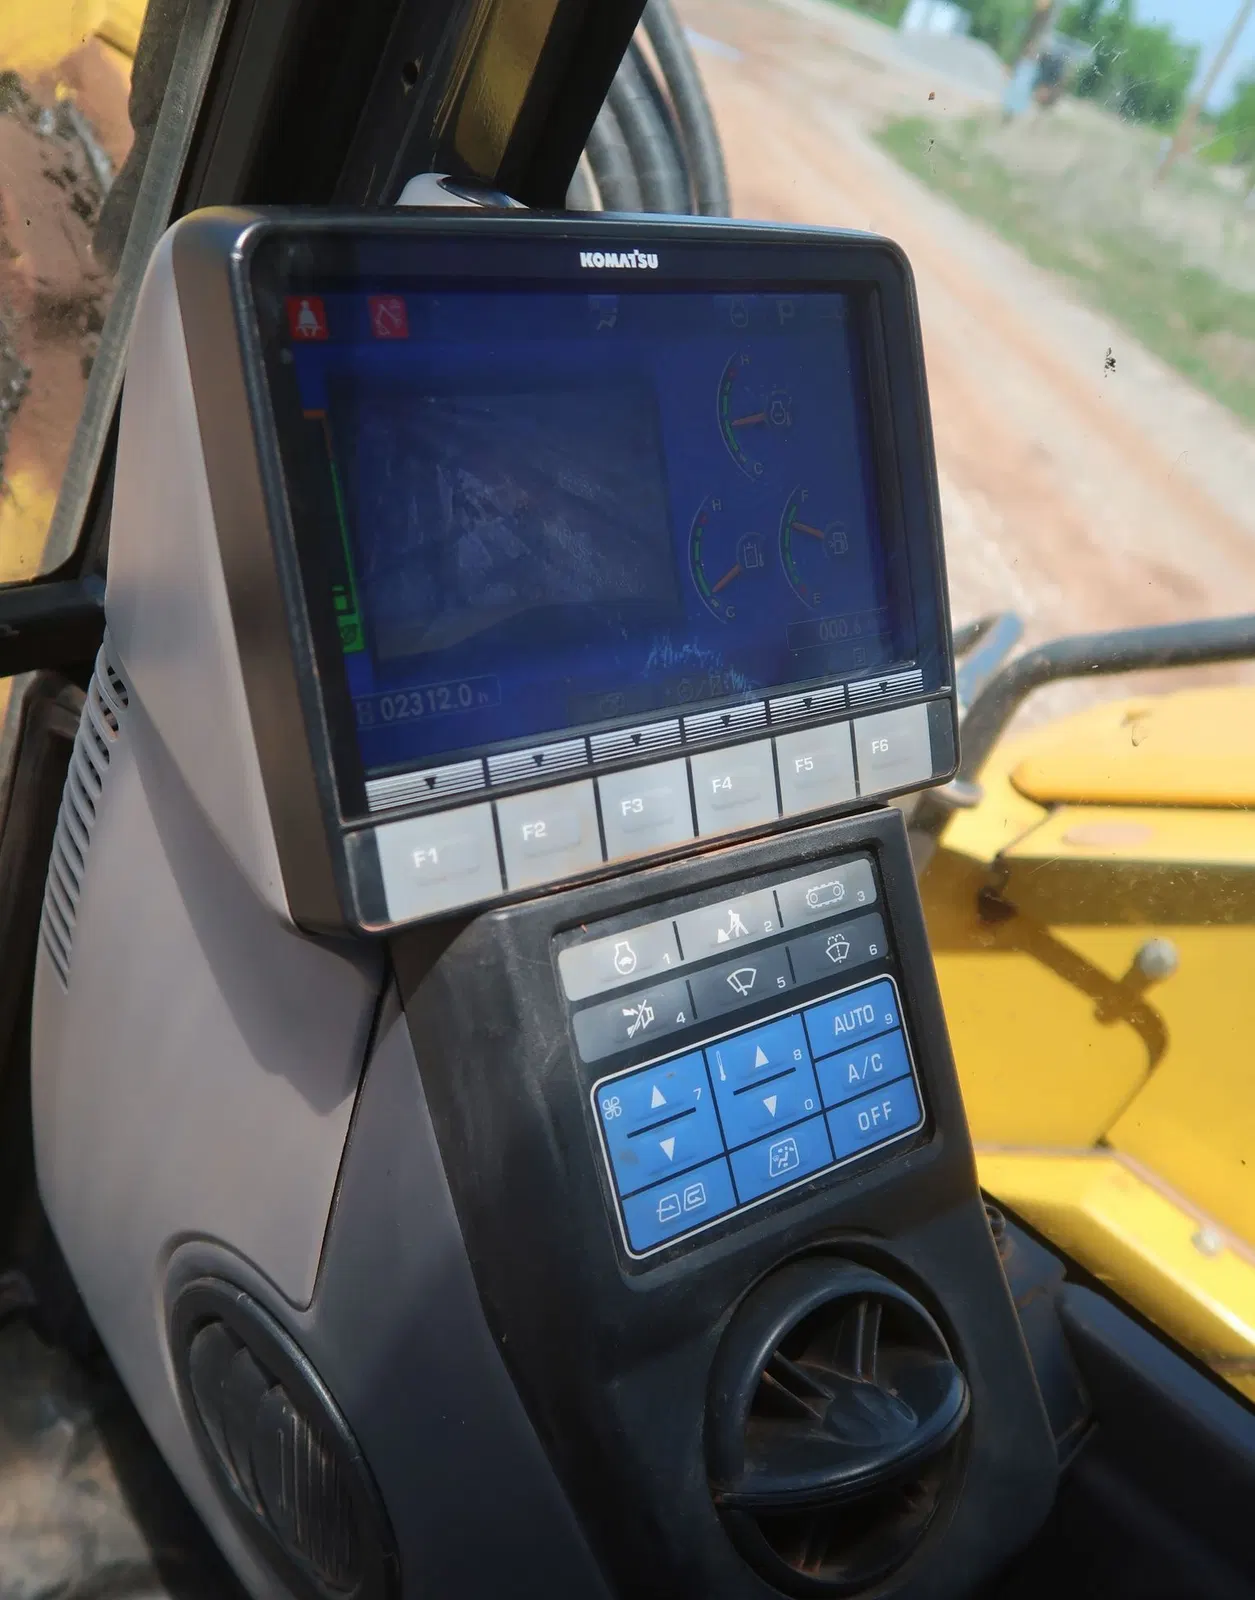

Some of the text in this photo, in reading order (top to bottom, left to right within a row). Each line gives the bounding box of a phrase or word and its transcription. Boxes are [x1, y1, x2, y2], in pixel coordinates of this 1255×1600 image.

[580, 249, 658, 269] KOMATSU
[871, 738, 889, 755] F6
[794, 756, 814, 774] F5
[711, 776, 733, 794] F4
[621, 797, 644, 816] F3
[521, 821, 547, 842] F2
[411, 847, 439, 869] F1
[857, 891, 866, 902] 3
[764, 921, 774, 932] 2
[869, 944, 878, 956] 6
[662, 953, 672, 965] 1
[777, 976, 787, 989] 5
[676, 1012, 686, 1025] 4
[834, 1004, 875, 1036] AUTO
[884, 1013, 894, 1025] 9
[793, 1049, 802, 1061] 8
[847, 1052, 884, 1084] A/C
[693, 1088, 702, 1101] 7
[804, 1099, 814, 1111] 0
[858, 1101, 893, 1132] OFF
